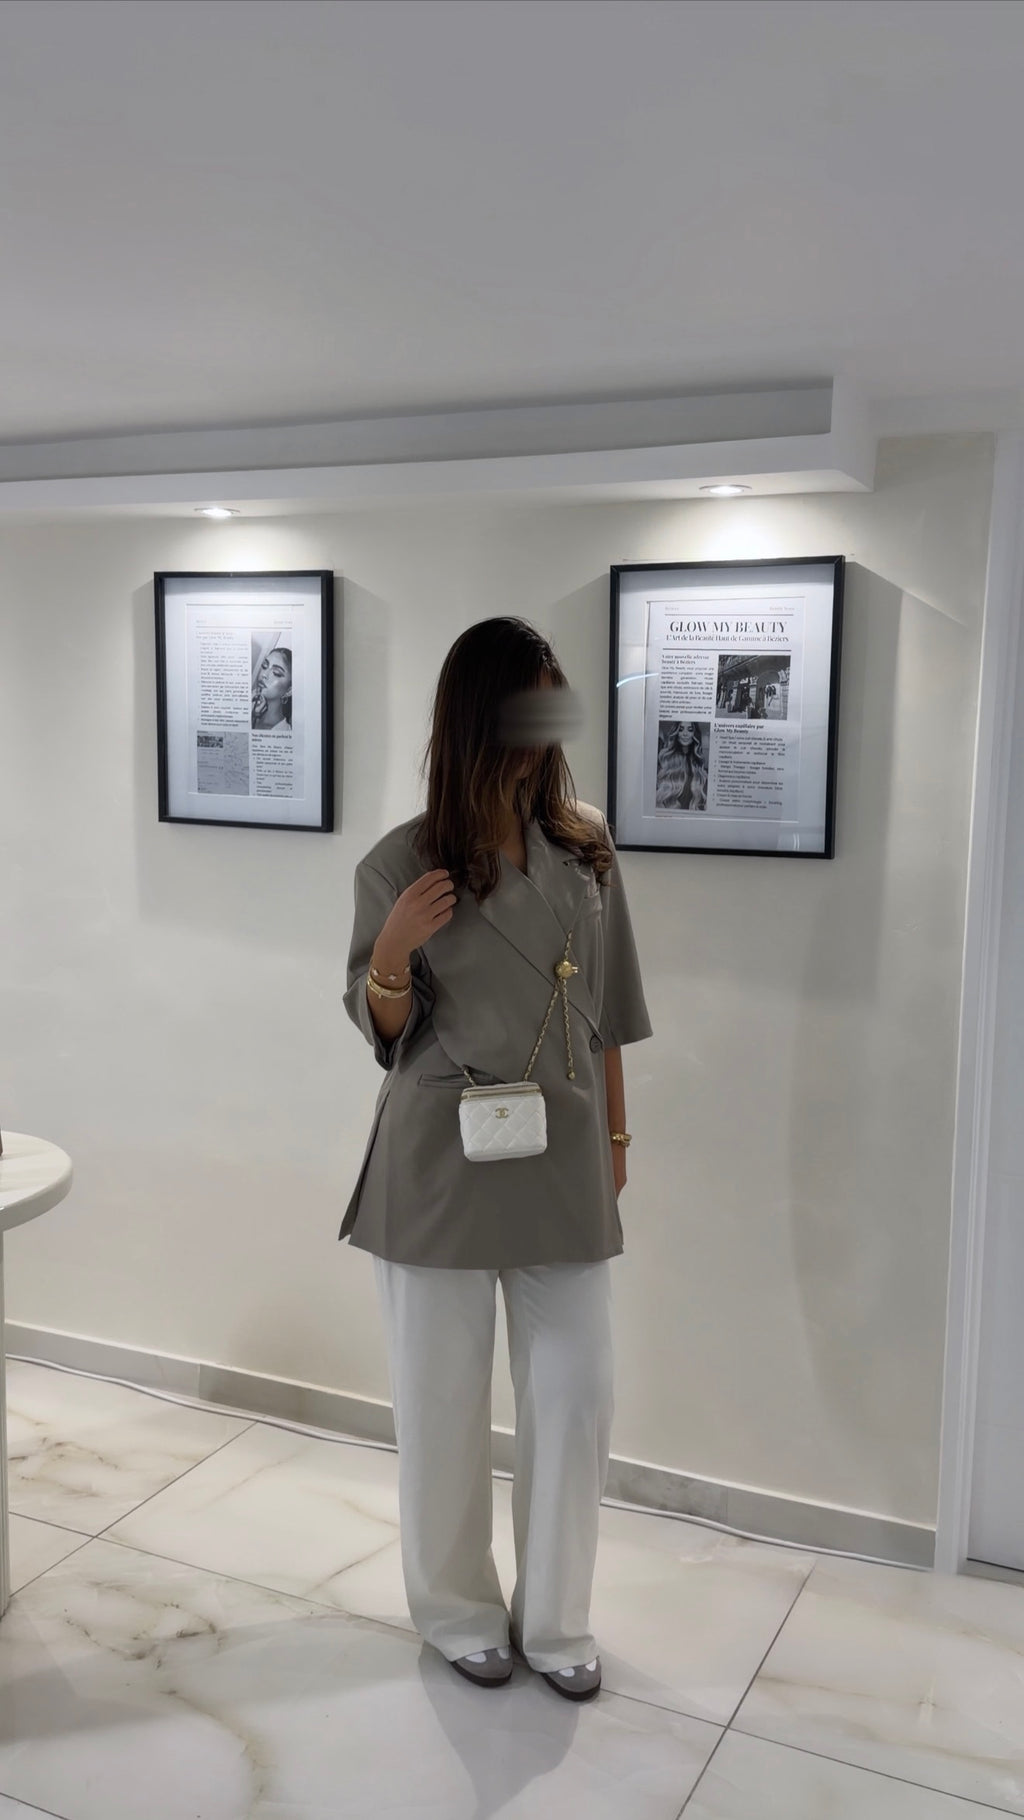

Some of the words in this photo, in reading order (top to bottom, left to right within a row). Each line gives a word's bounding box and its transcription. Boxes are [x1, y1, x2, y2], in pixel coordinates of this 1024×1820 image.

[670, 621, 710, 632] GLOW
[713, 621, 732, 632] MY
[735, 622, 787, 633] BEAUTY
